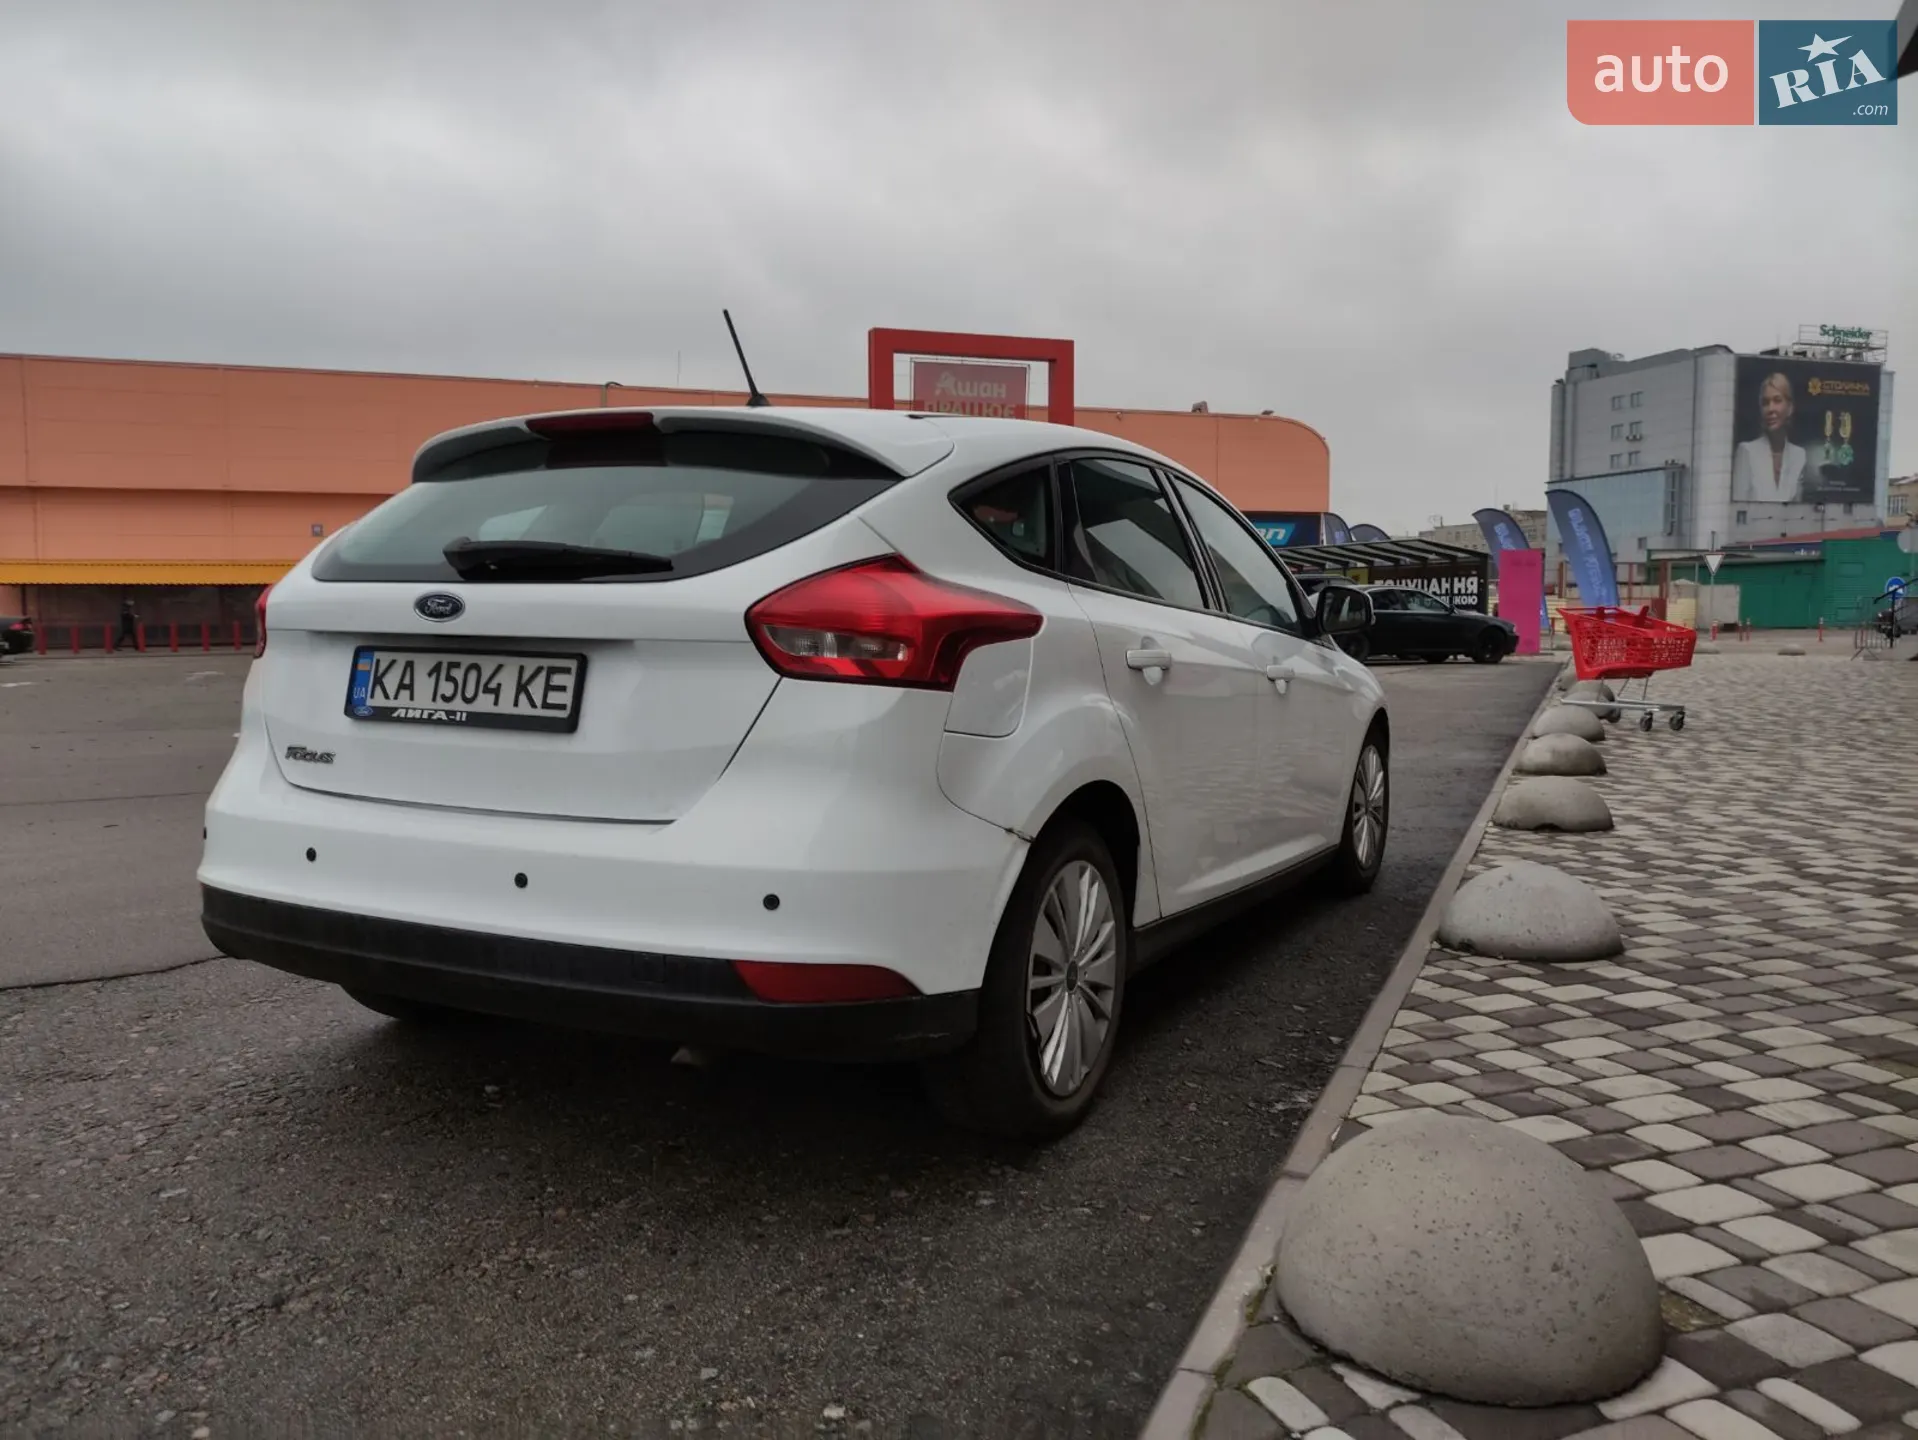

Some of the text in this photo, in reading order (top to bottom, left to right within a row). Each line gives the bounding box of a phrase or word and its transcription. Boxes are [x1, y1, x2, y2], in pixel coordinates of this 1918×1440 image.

[935, 371, 1006, 398] Ашан
[353, 686, 366, 699] UA
[370, 658, 572, 711] KA 1504 KE
